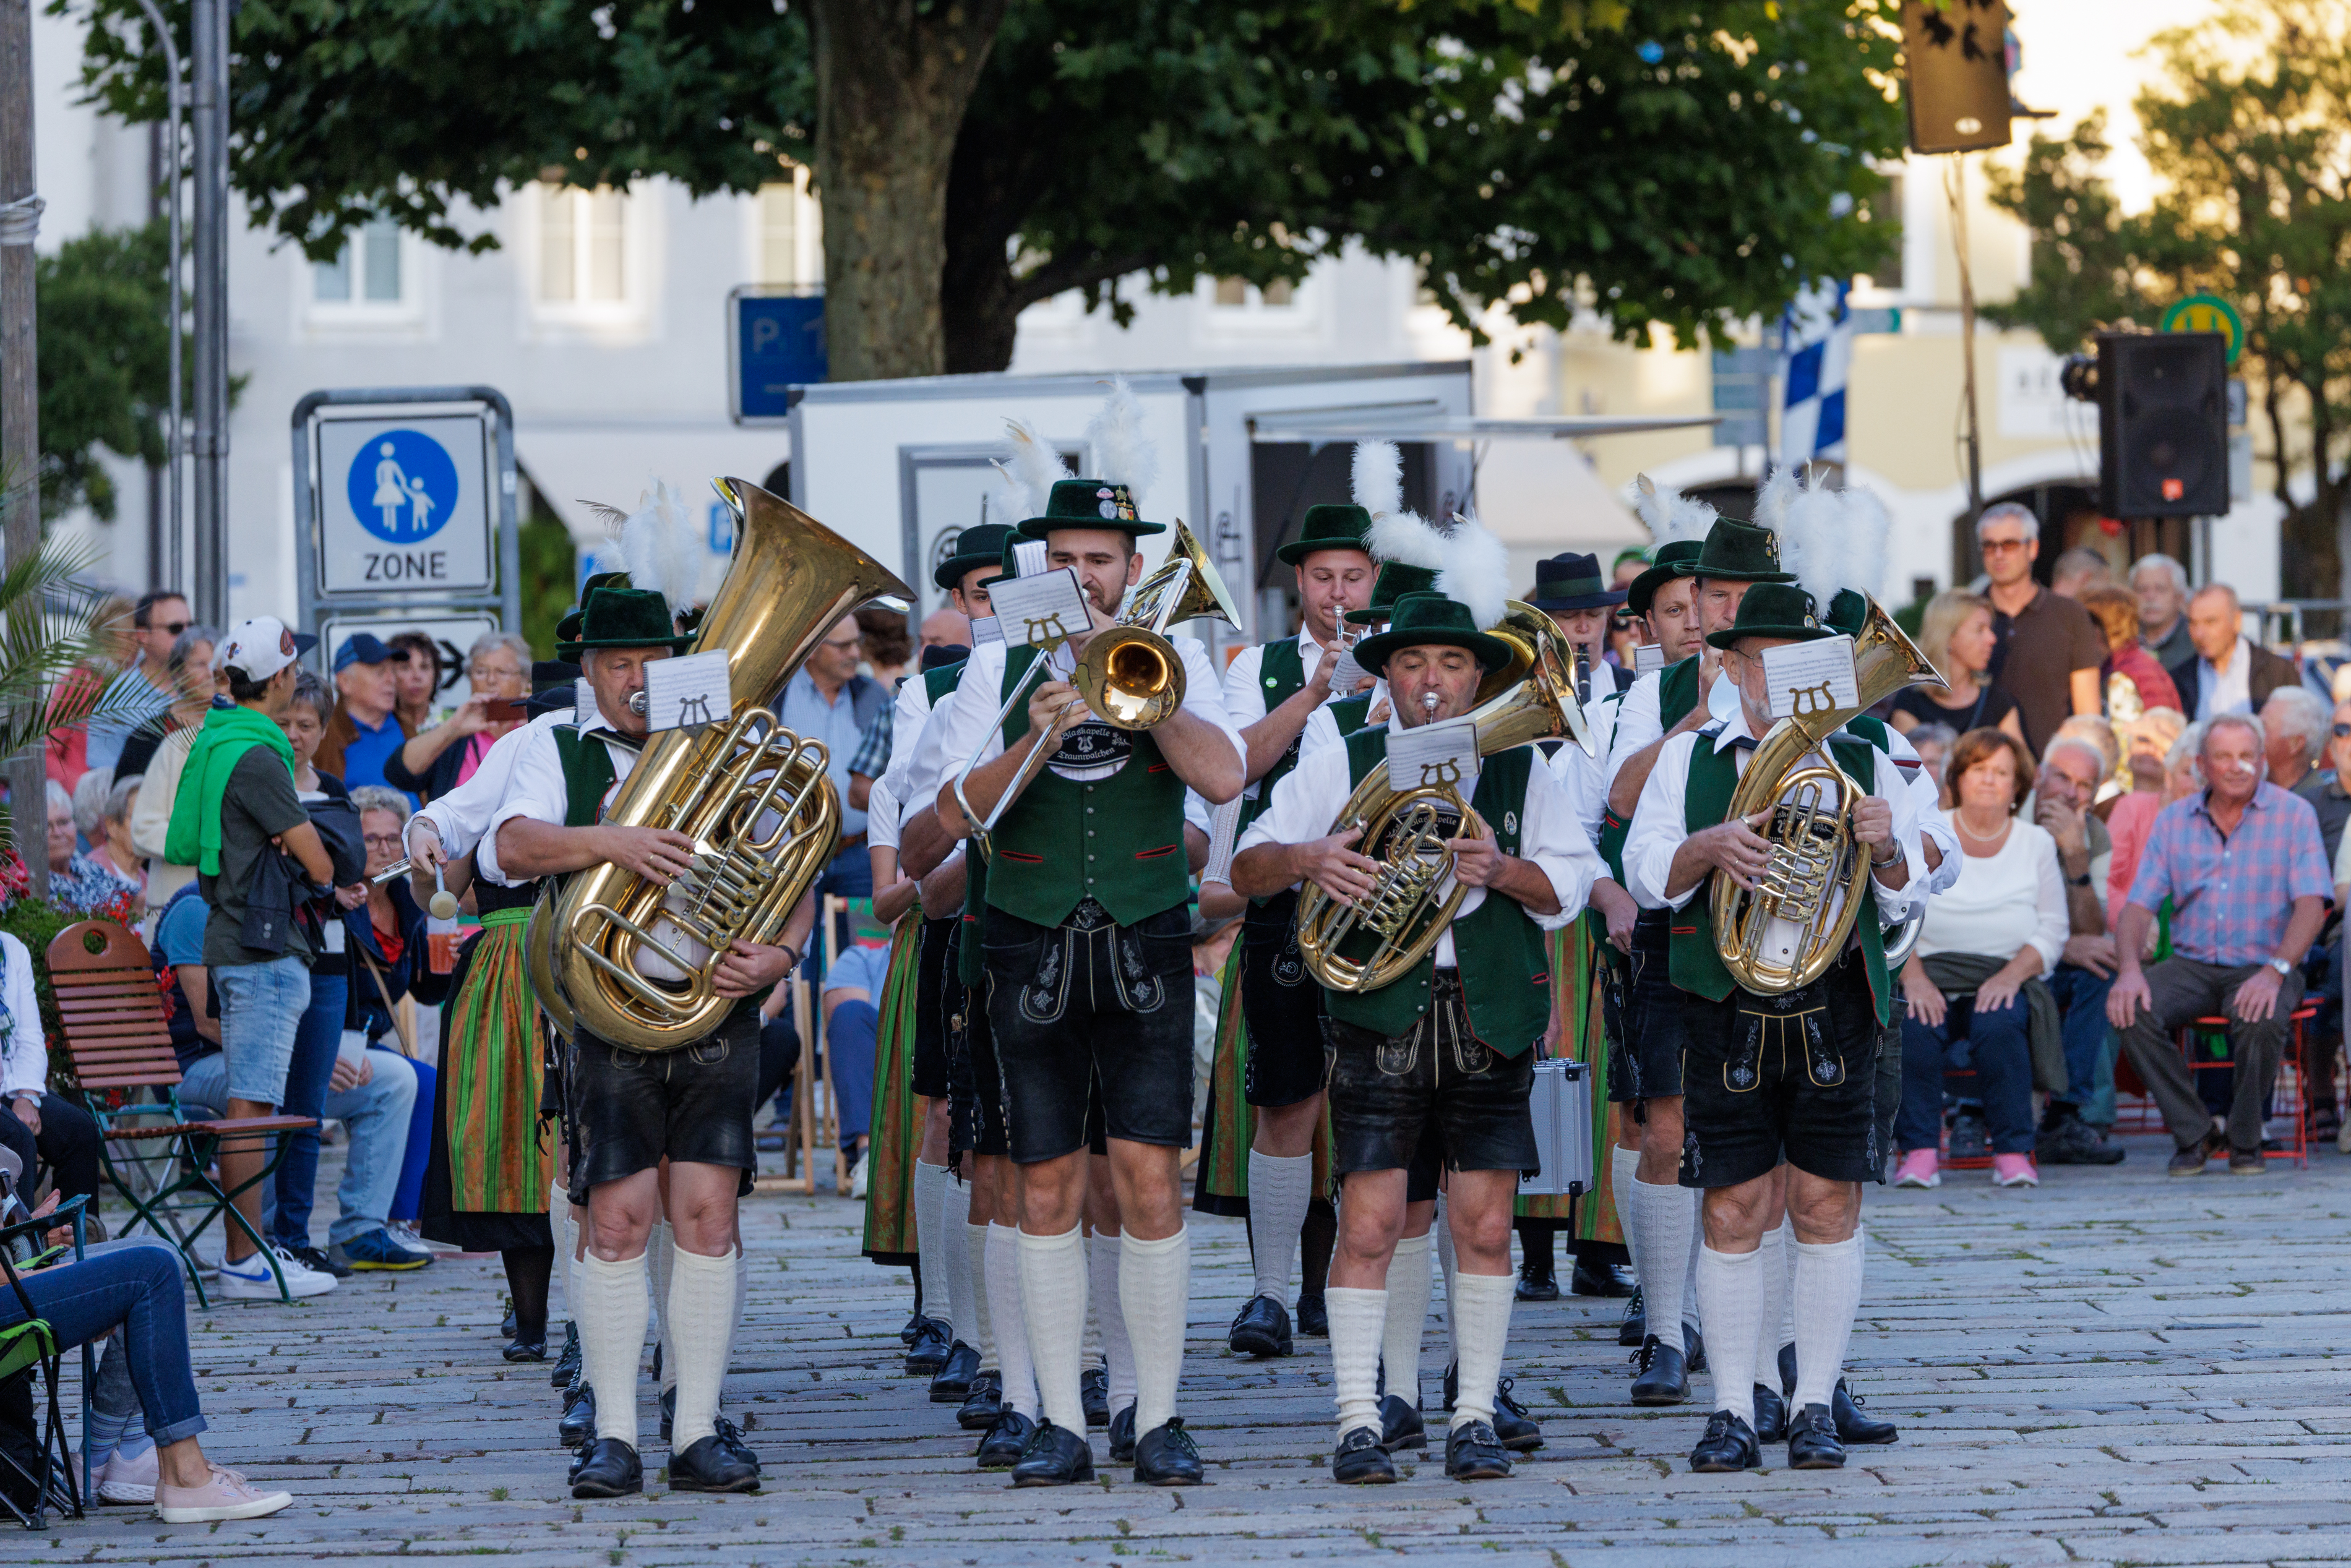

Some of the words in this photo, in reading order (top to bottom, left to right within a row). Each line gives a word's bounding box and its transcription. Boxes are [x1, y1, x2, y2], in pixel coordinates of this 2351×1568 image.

[753, 317, 780, 354] P
[364, 551, 447, 580] ZONE
[1061, 726, 1111, 740] Blaskapelle
[1057, 747, 1115, 760] Traunwalchen
